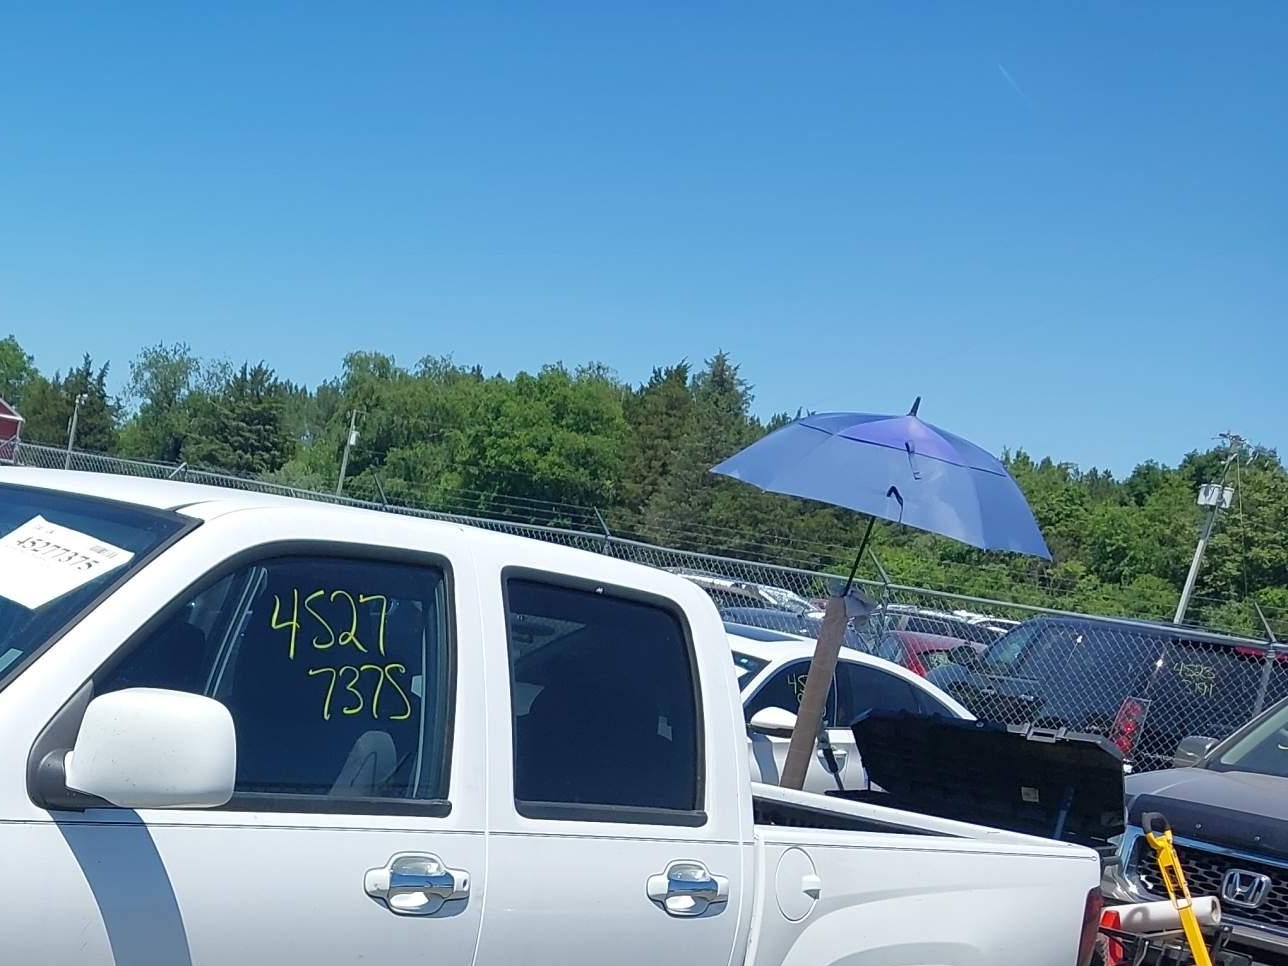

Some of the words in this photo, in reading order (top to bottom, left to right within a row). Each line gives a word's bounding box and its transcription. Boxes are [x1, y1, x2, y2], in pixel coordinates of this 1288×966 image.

[16, 535, 100, 571] 45277375
[271, 588, 386, 660] 4527
[308, 663, 411, 721] 7375
